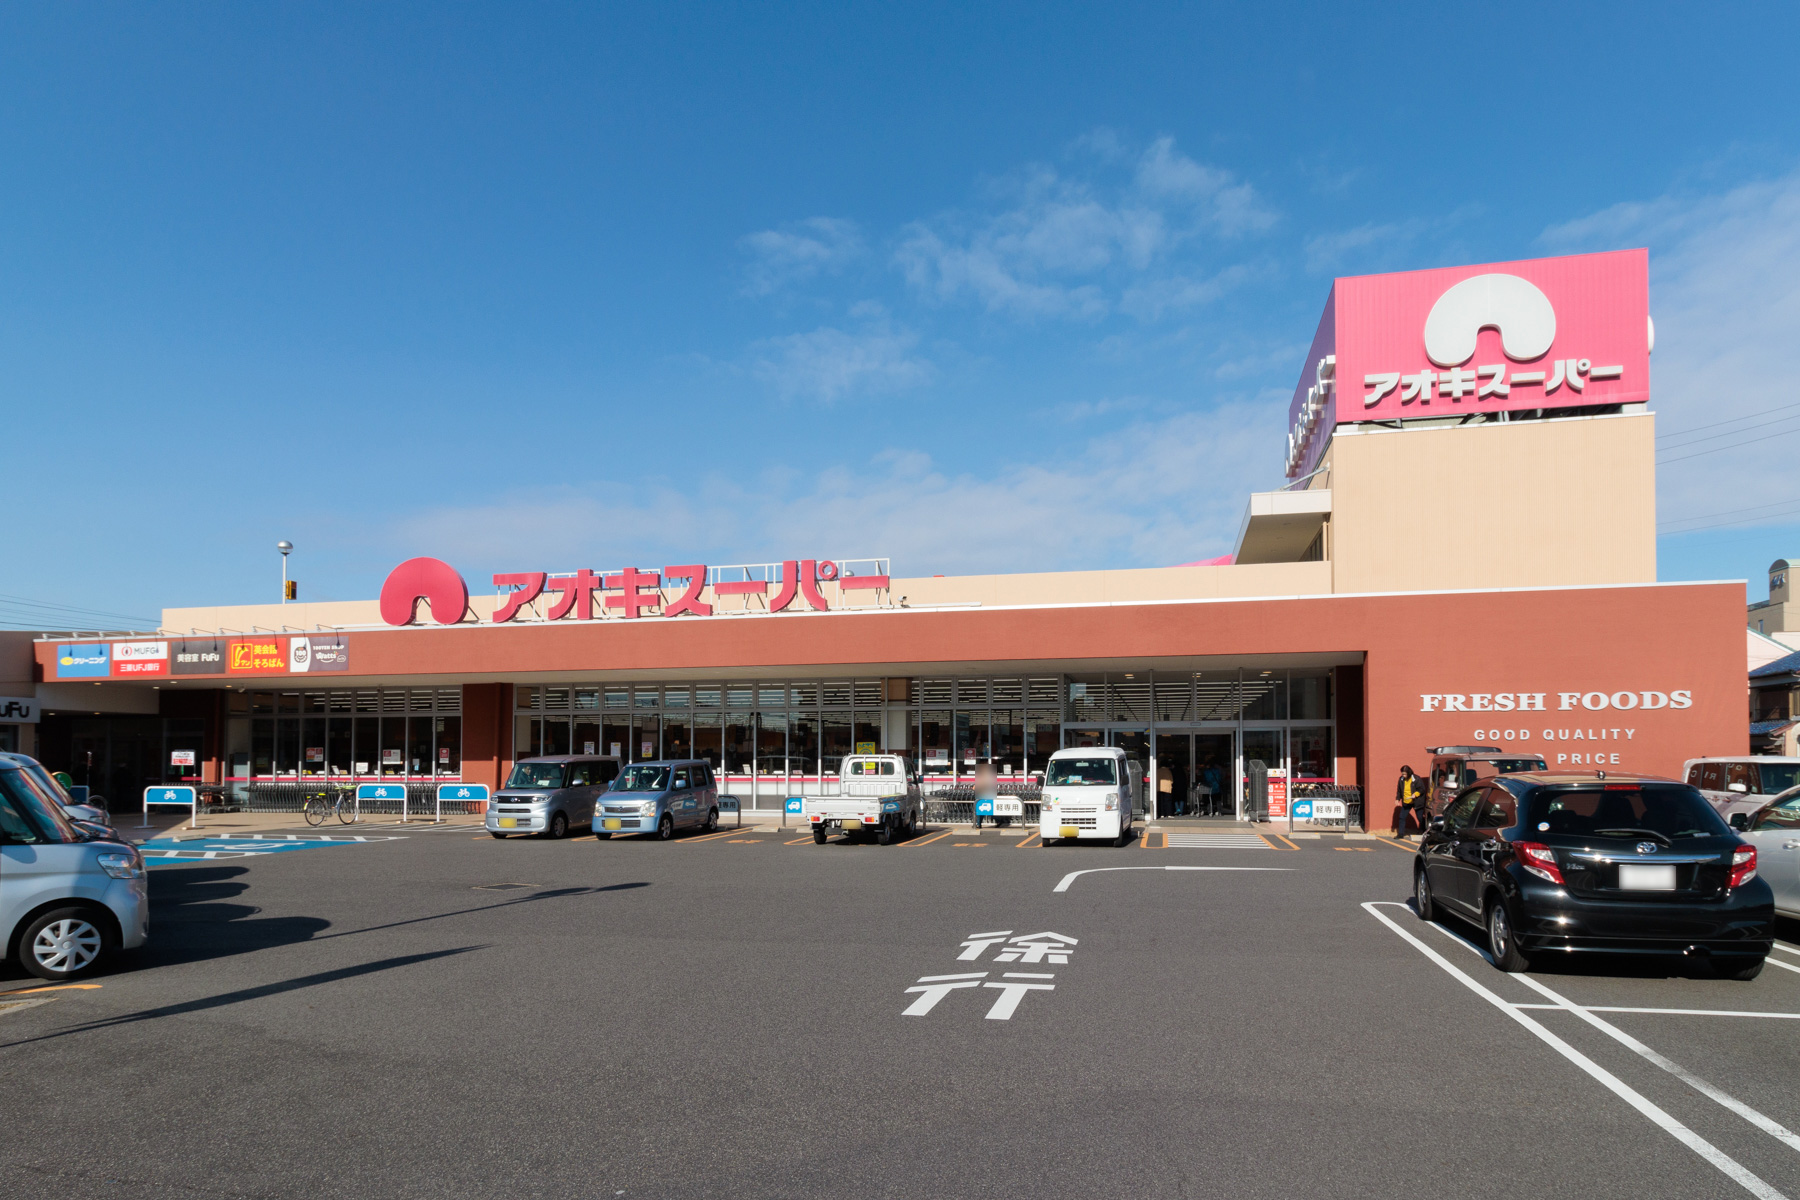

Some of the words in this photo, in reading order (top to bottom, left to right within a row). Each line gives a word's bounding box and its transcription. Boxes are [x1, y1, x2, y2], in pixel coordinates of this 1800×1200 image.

[1364, 358, 1623, 408] アオキスーパー
[493, 558, 890, 623] アオキスーパー
[134, 647, 156, 655] MUFG
[254, 645, 277, 654] 英会話
[177, 653, 199, 663] 美容室
[253, 658, 284, 668] そろばん
[1420, 693, 1547, 712] FRESH
[1557, 690, 1693, 711] FOODS
[1474, 729, 1531, 741] GOOD
[1543, 728, 1636, 741] QUALITY
[1557, 753, 1621, 765] PRICE
[996, 803, 1019, 812] 軽専用
